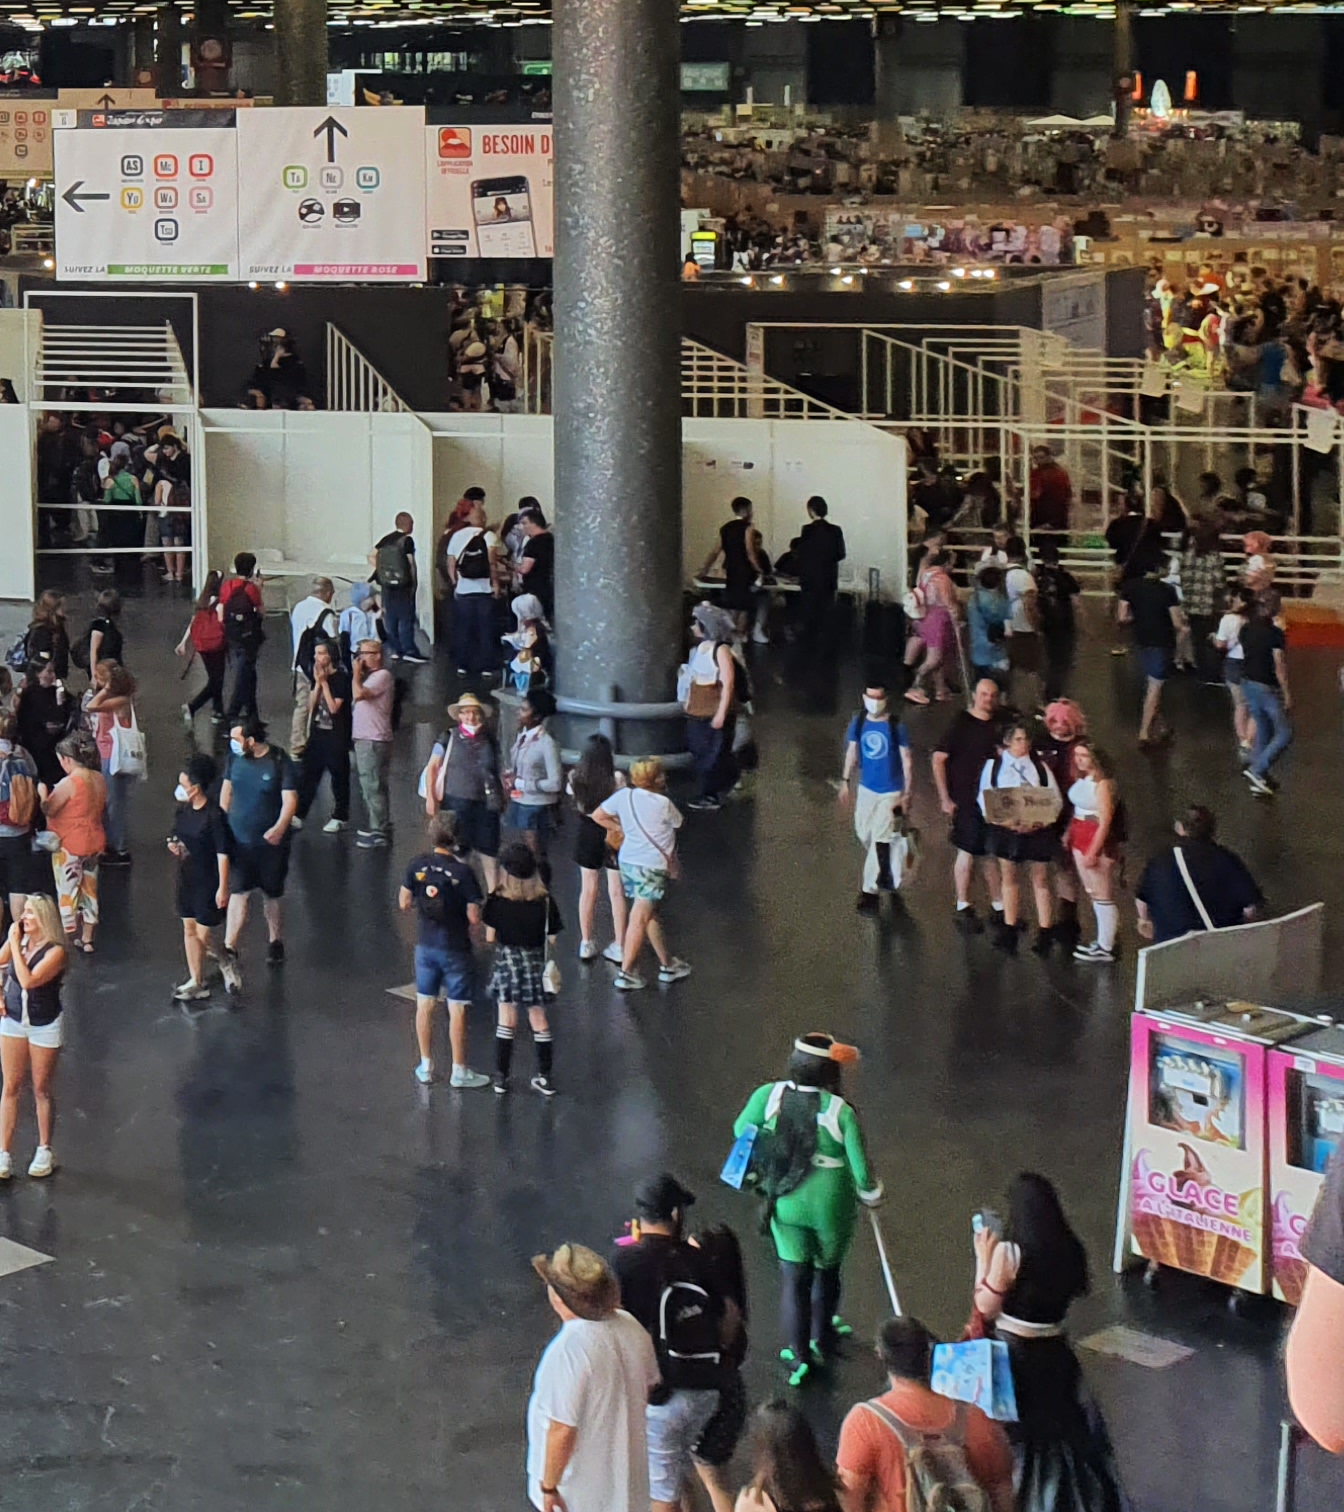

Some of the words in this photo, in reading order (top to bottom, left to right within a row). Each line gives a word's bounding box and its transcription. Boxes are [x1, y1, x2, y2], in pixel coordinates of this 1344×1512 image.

[482, 134, 534, 154] BESOIN
[126, 160, 138, 171] AS
[124, 265, 177, 274] MOQUETTE
[181, 265, 211, 274] VERTE
[249, 265, 279, 273] SUIVEZ
[313, 265, 368, 274] MOQUETTE
[370, 265, 398, 274] ROSE
[1147, 1171, 1240, 1217] GLACE
